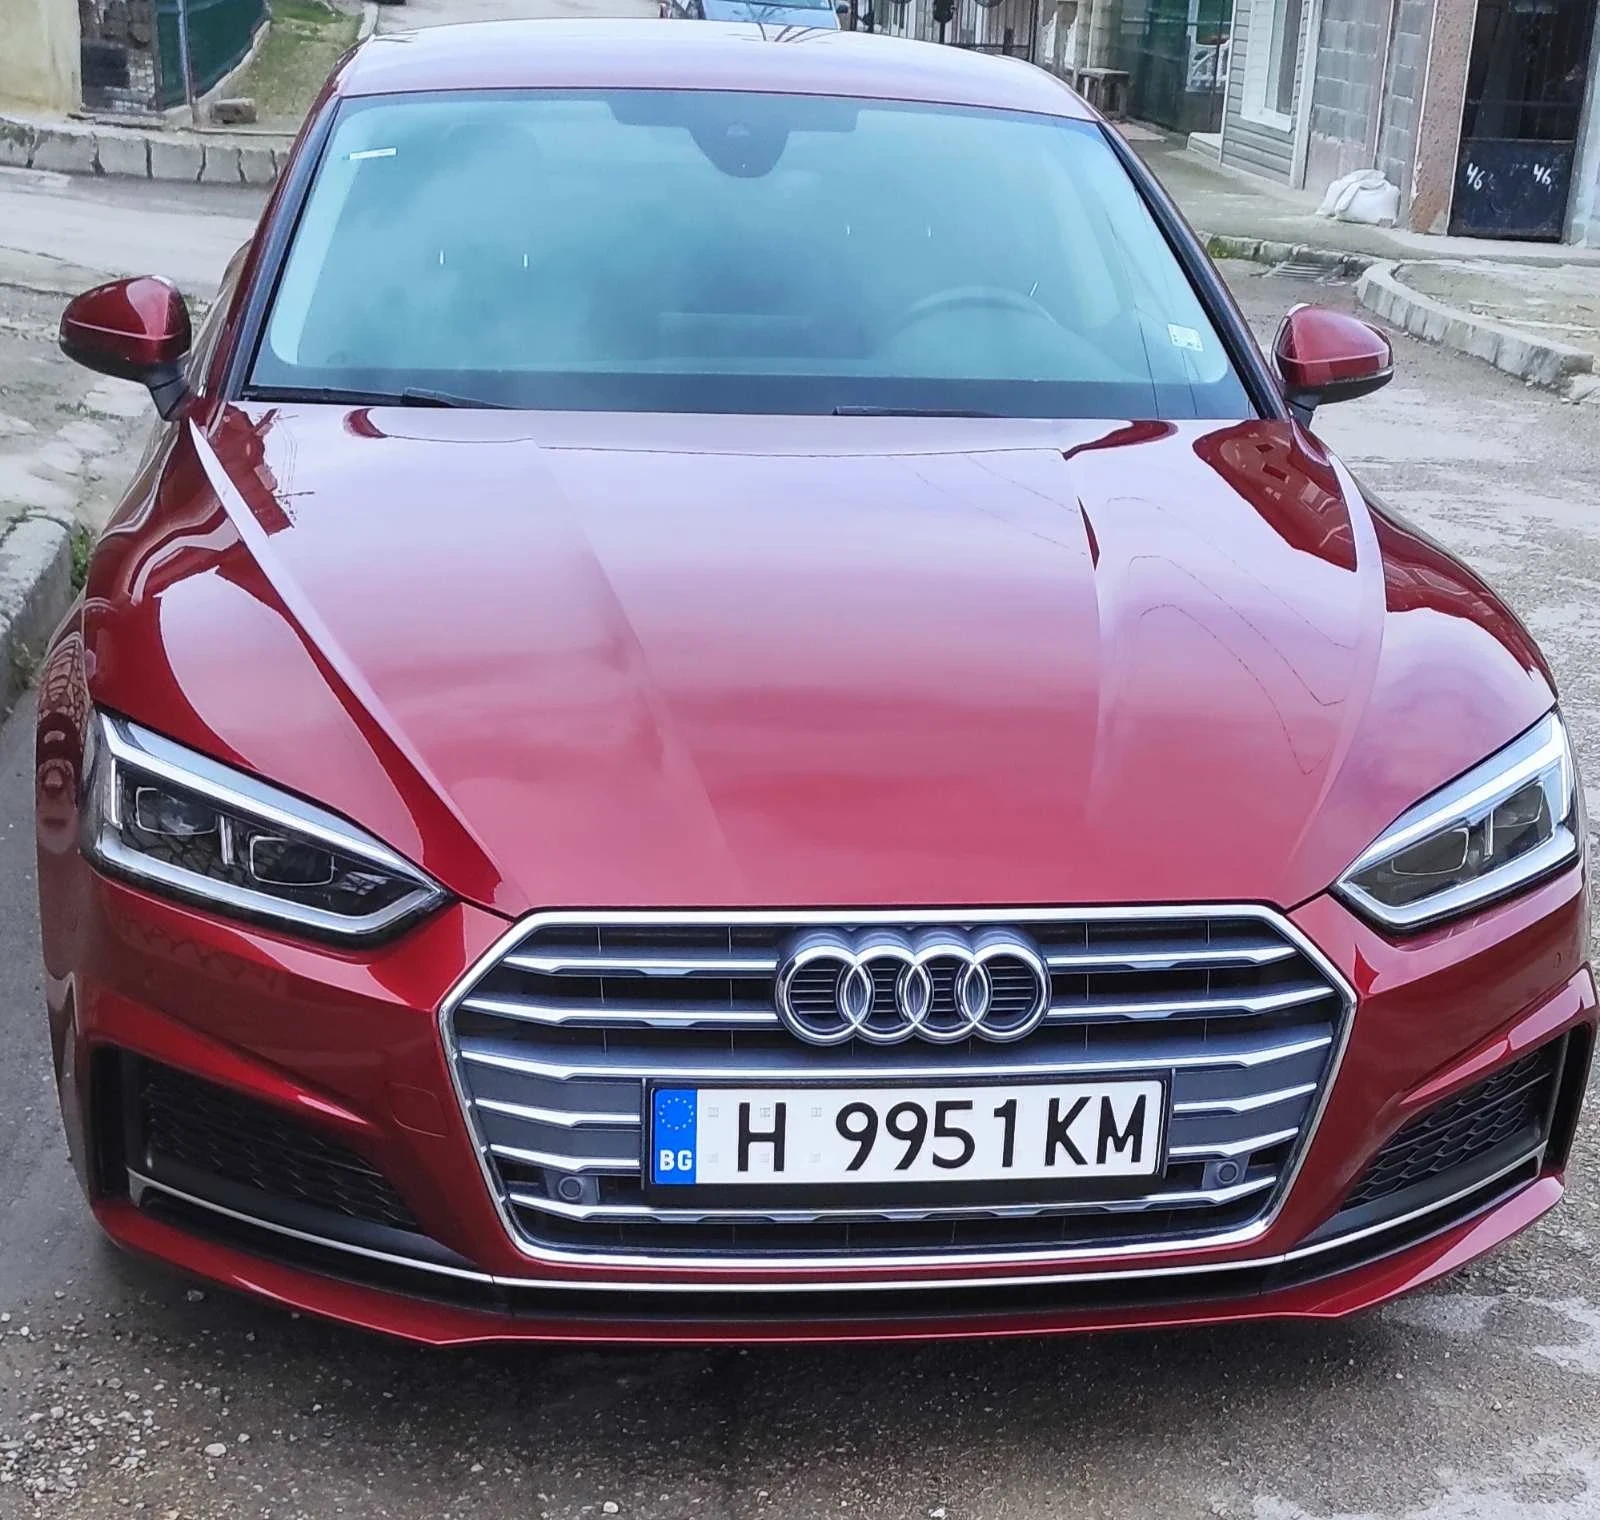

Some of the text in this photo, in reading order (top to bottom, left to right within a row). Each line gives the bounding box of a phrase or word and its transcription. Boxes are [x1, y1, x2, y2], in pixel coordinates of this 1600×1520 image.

[1466, 162, 1486, 191] 46
[1533, 163, 1552, 185] 46
[737, 1094, 1147, 1172] H 9951 KM
[659, 1149, 693, 1171] BG
